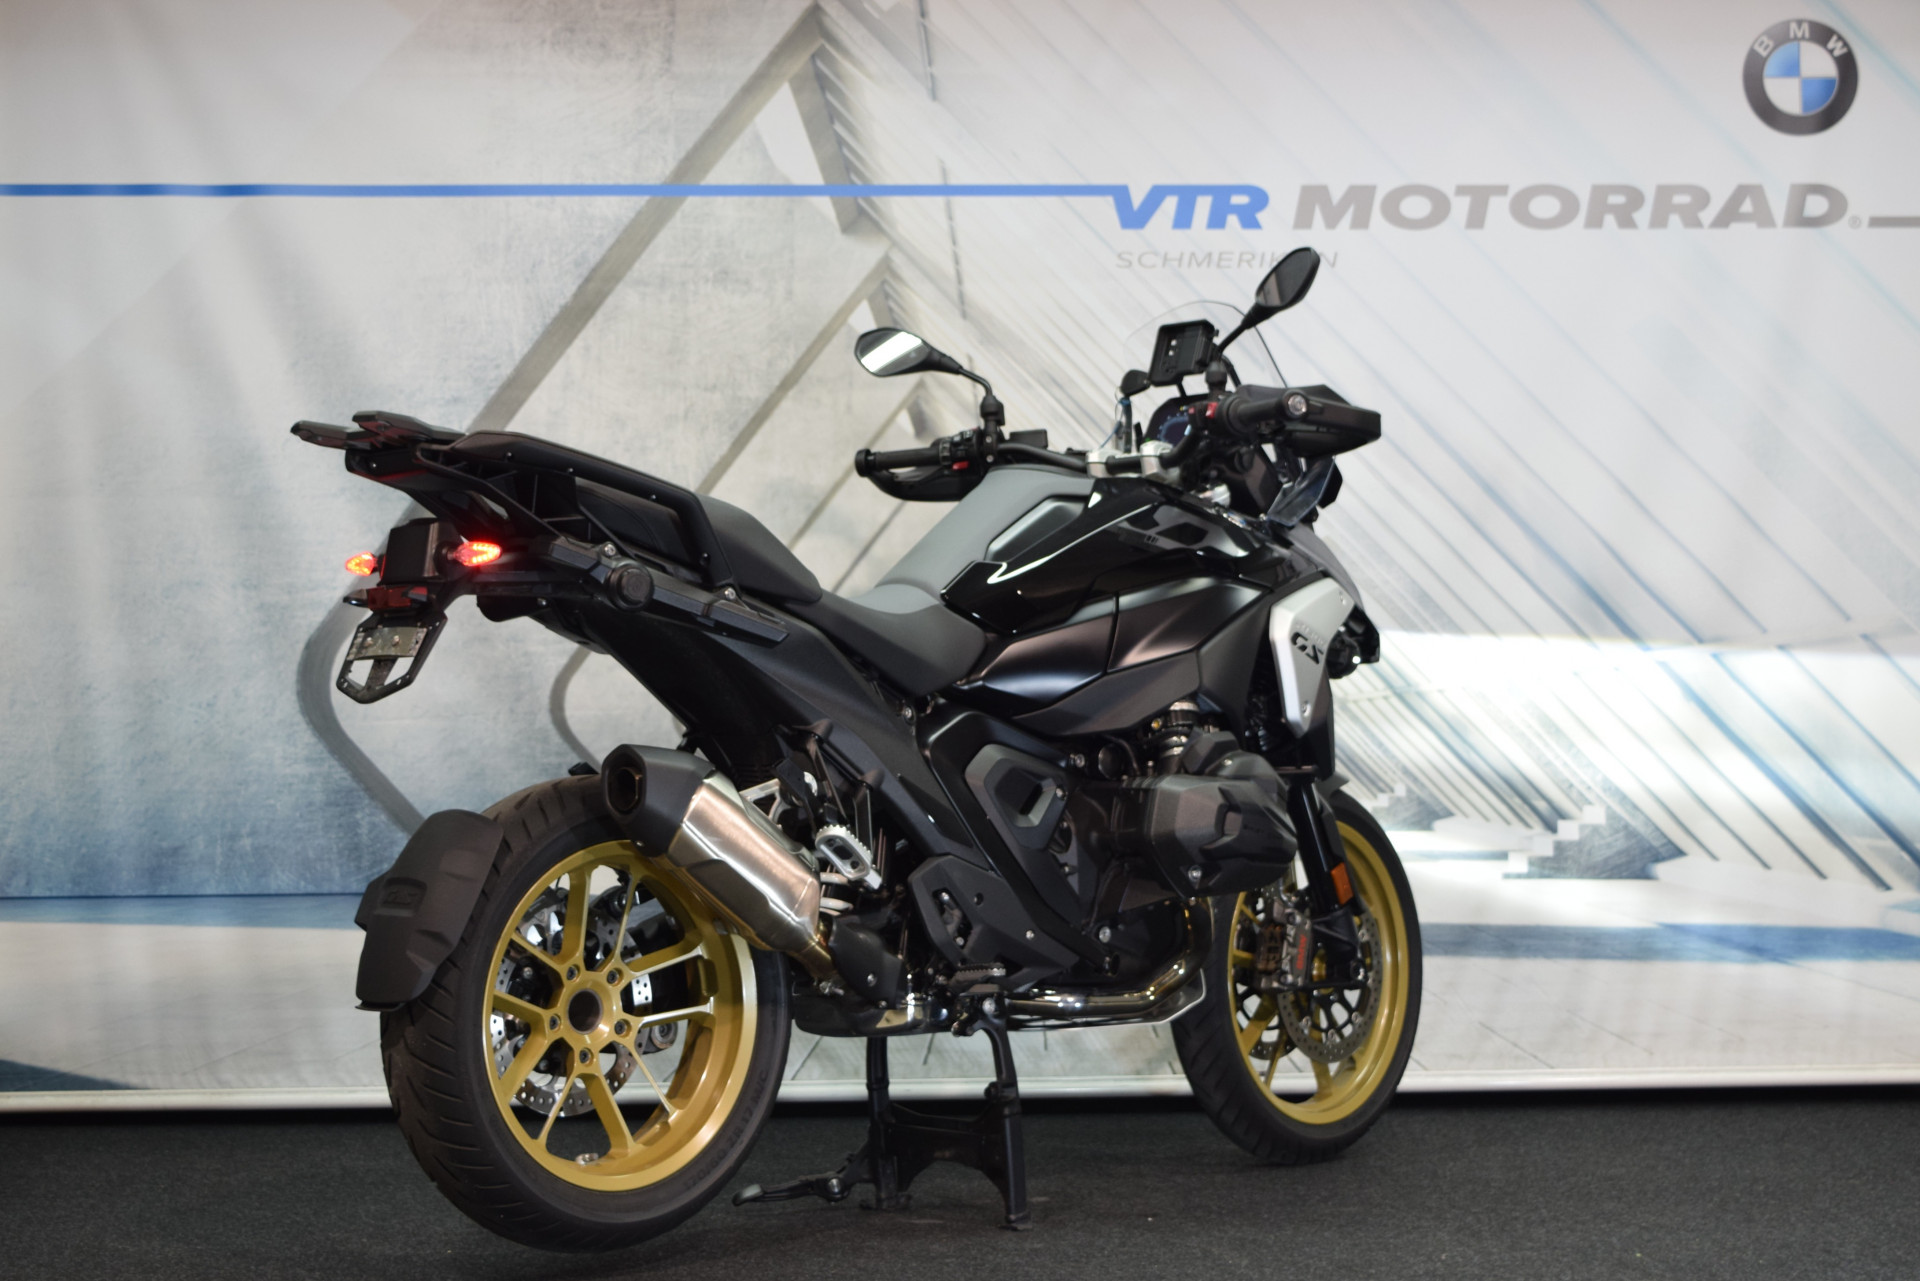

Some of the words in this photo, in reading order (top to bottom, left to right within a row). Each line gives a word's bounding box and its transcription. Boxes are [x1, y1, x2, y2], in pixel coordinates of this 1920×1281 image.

[1753, 21, 1848, 58] BMW
[1112, 184, 1270, 230] VTR
[1116, 251, 1338, 269] SCHMERIKN
